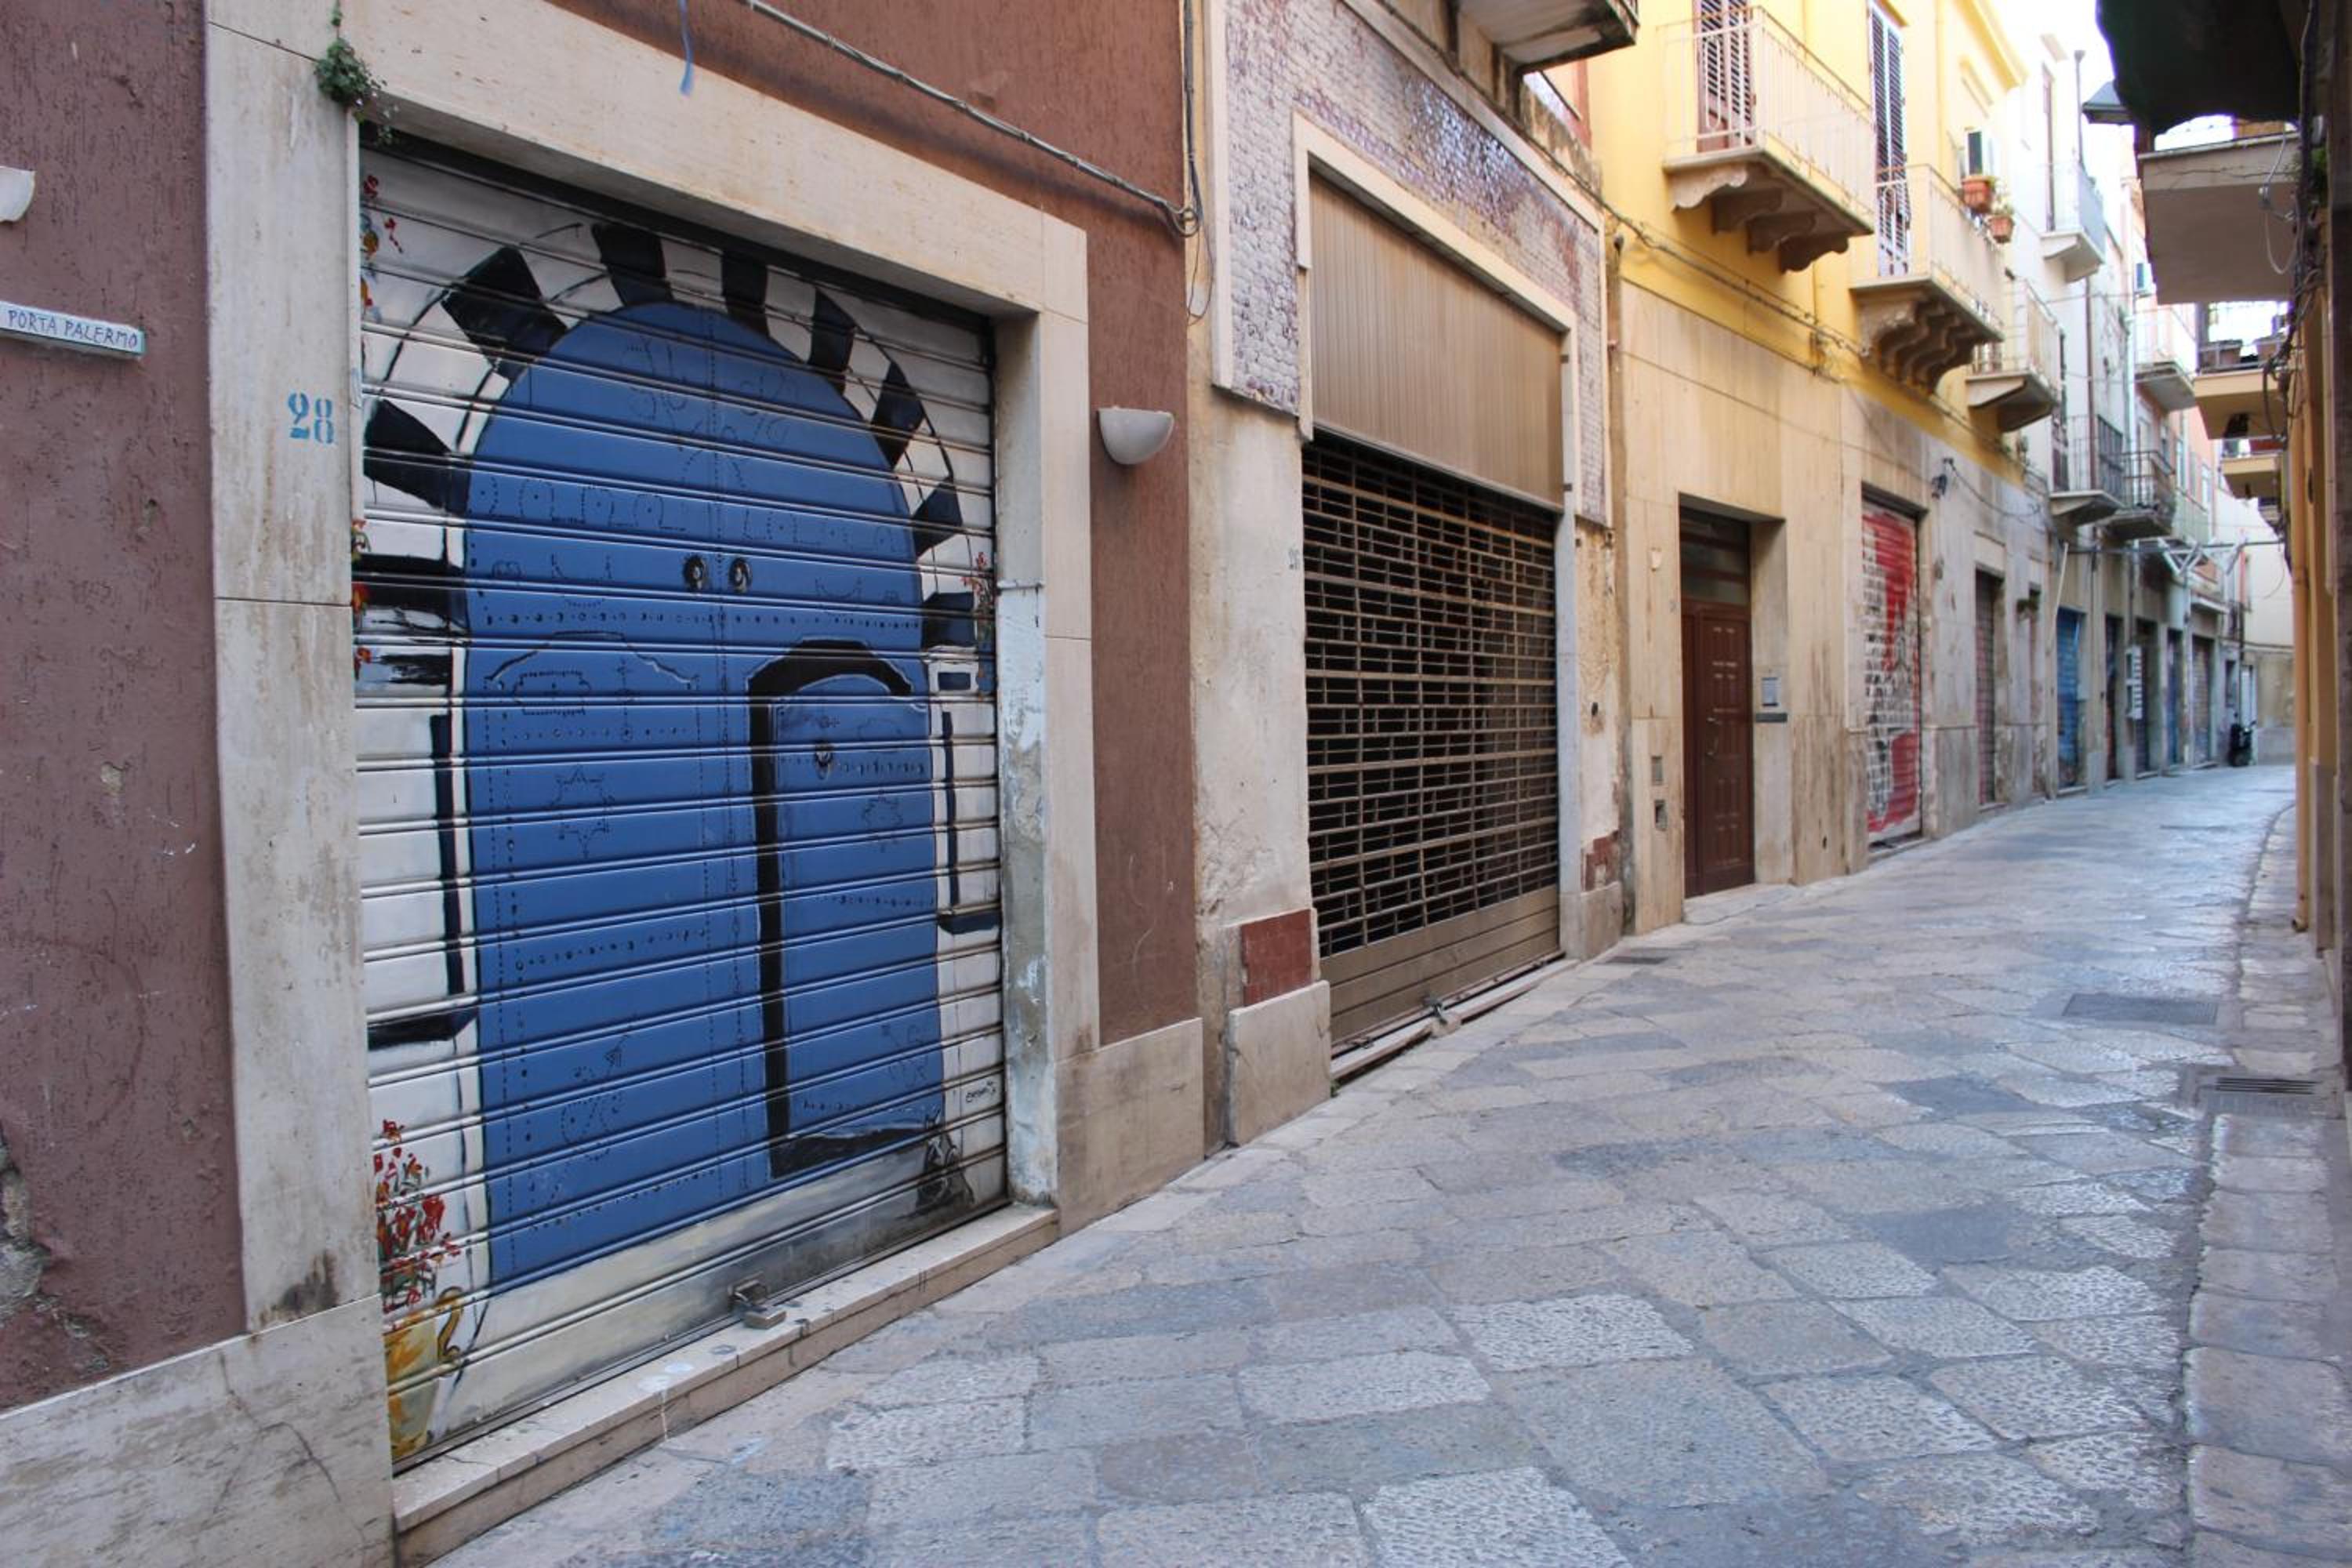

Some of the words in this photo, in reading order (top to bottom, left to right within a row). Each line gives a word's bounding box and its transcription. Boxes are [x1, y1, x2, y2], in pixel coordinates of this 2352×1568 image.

[8, 310, 57, 335] PORTA
[64, 319, 137, 348] PALERMO
[288, 392, 334, 444] 28
